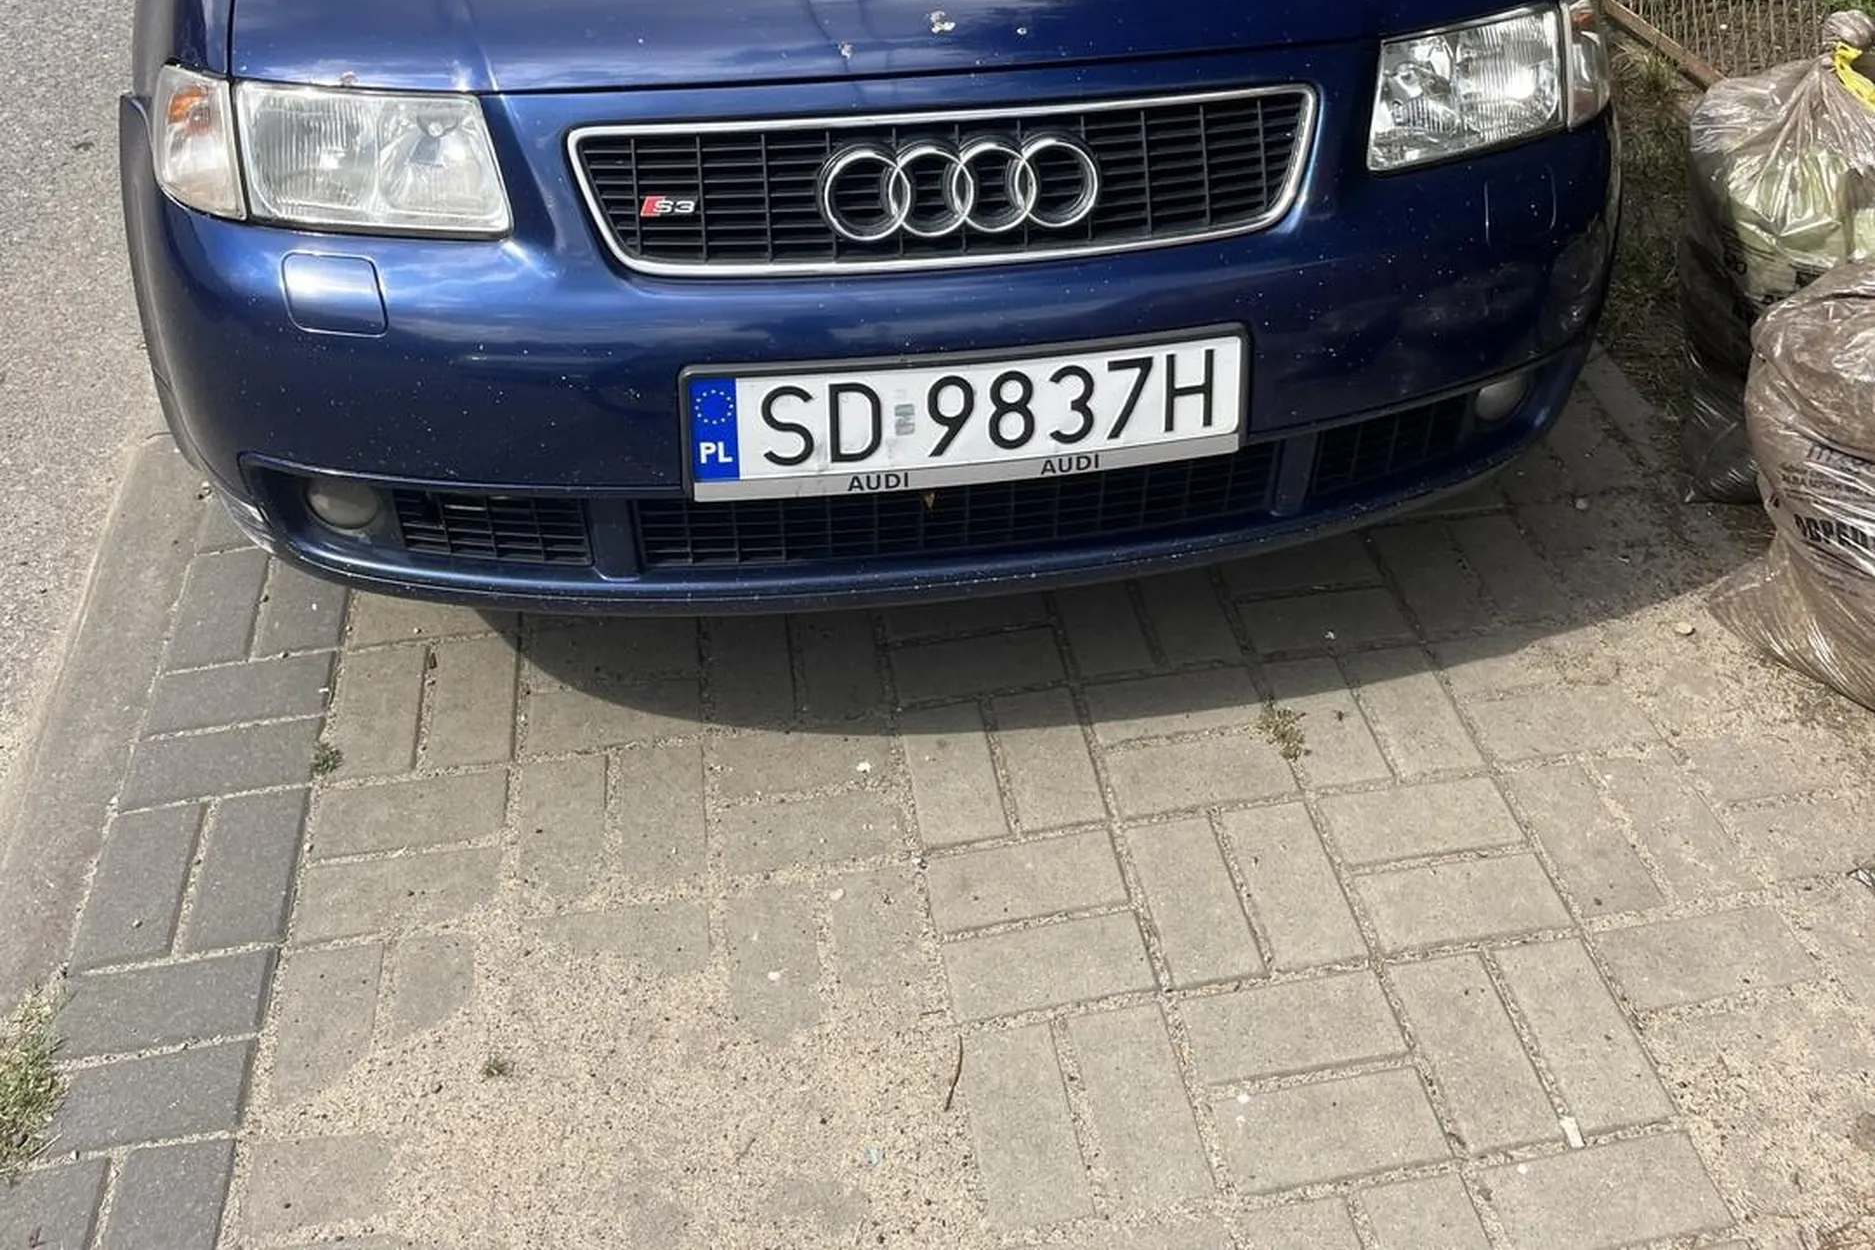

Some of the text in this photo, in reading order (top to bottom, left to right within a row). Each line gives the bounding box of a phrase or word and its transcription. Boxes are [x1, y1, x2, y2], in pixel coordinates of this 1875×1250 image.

[652, 200, 696, 213] S3
[762, 348, 1214, 467] SD 9837H
[700, 441, 733, 464] PL
[848, 453, 1099, 492] AUDI AUDI
